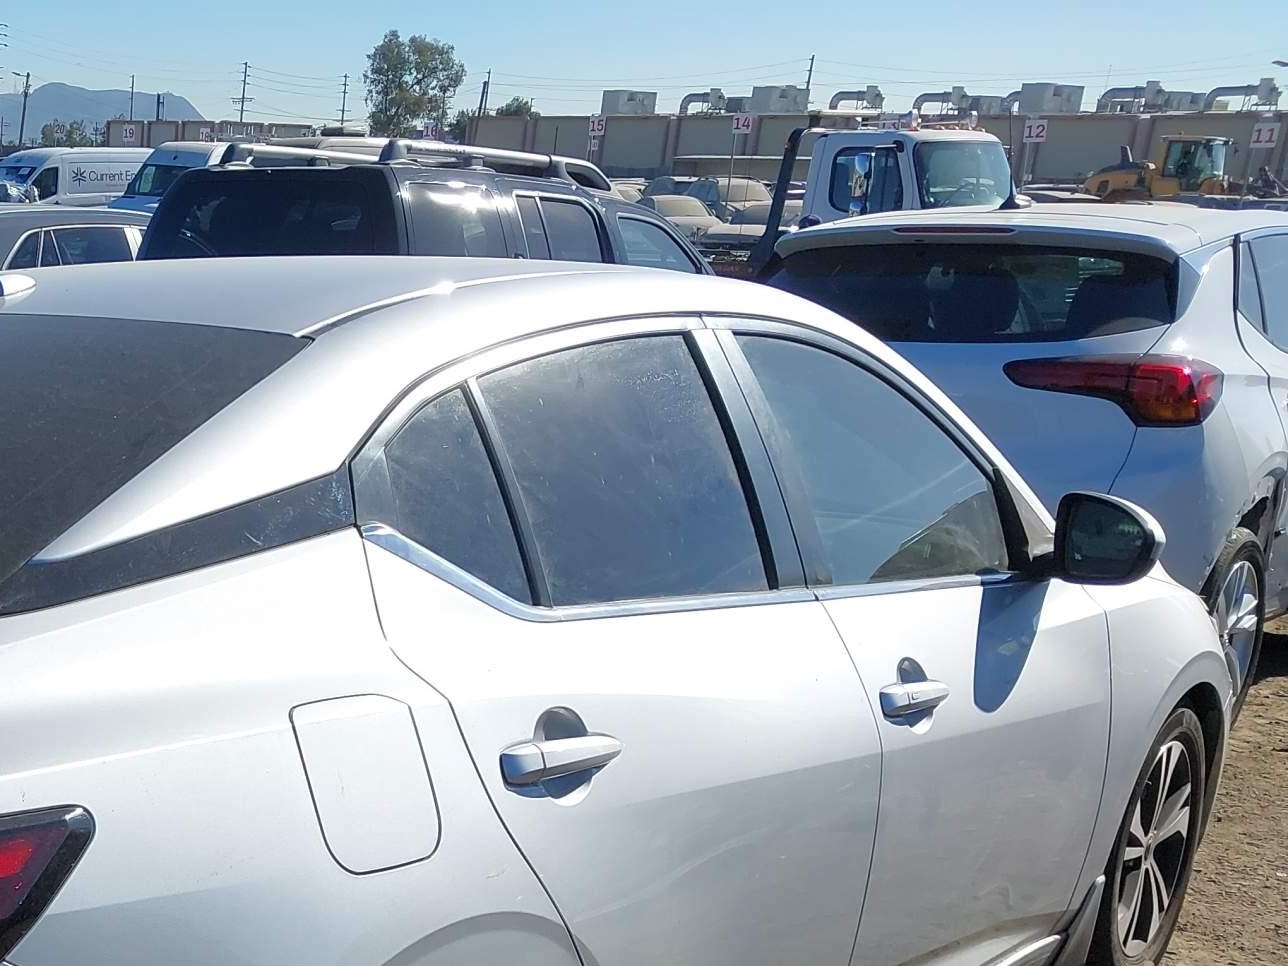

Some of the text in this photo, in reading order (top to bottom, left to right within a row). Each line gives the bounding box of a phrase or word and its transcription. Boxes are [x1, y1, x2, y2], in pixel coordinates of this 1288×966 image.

[55, 124, 65, 134] 20
[590, 119, 604, 131] 15
[734, 117, 750, 130] 14
[123, 128, 135, 139] 19
[1025, 124, 1045, 139] 12
[1252, 127, 1275, 144] 11
[88, 170, 124, 181] Current
